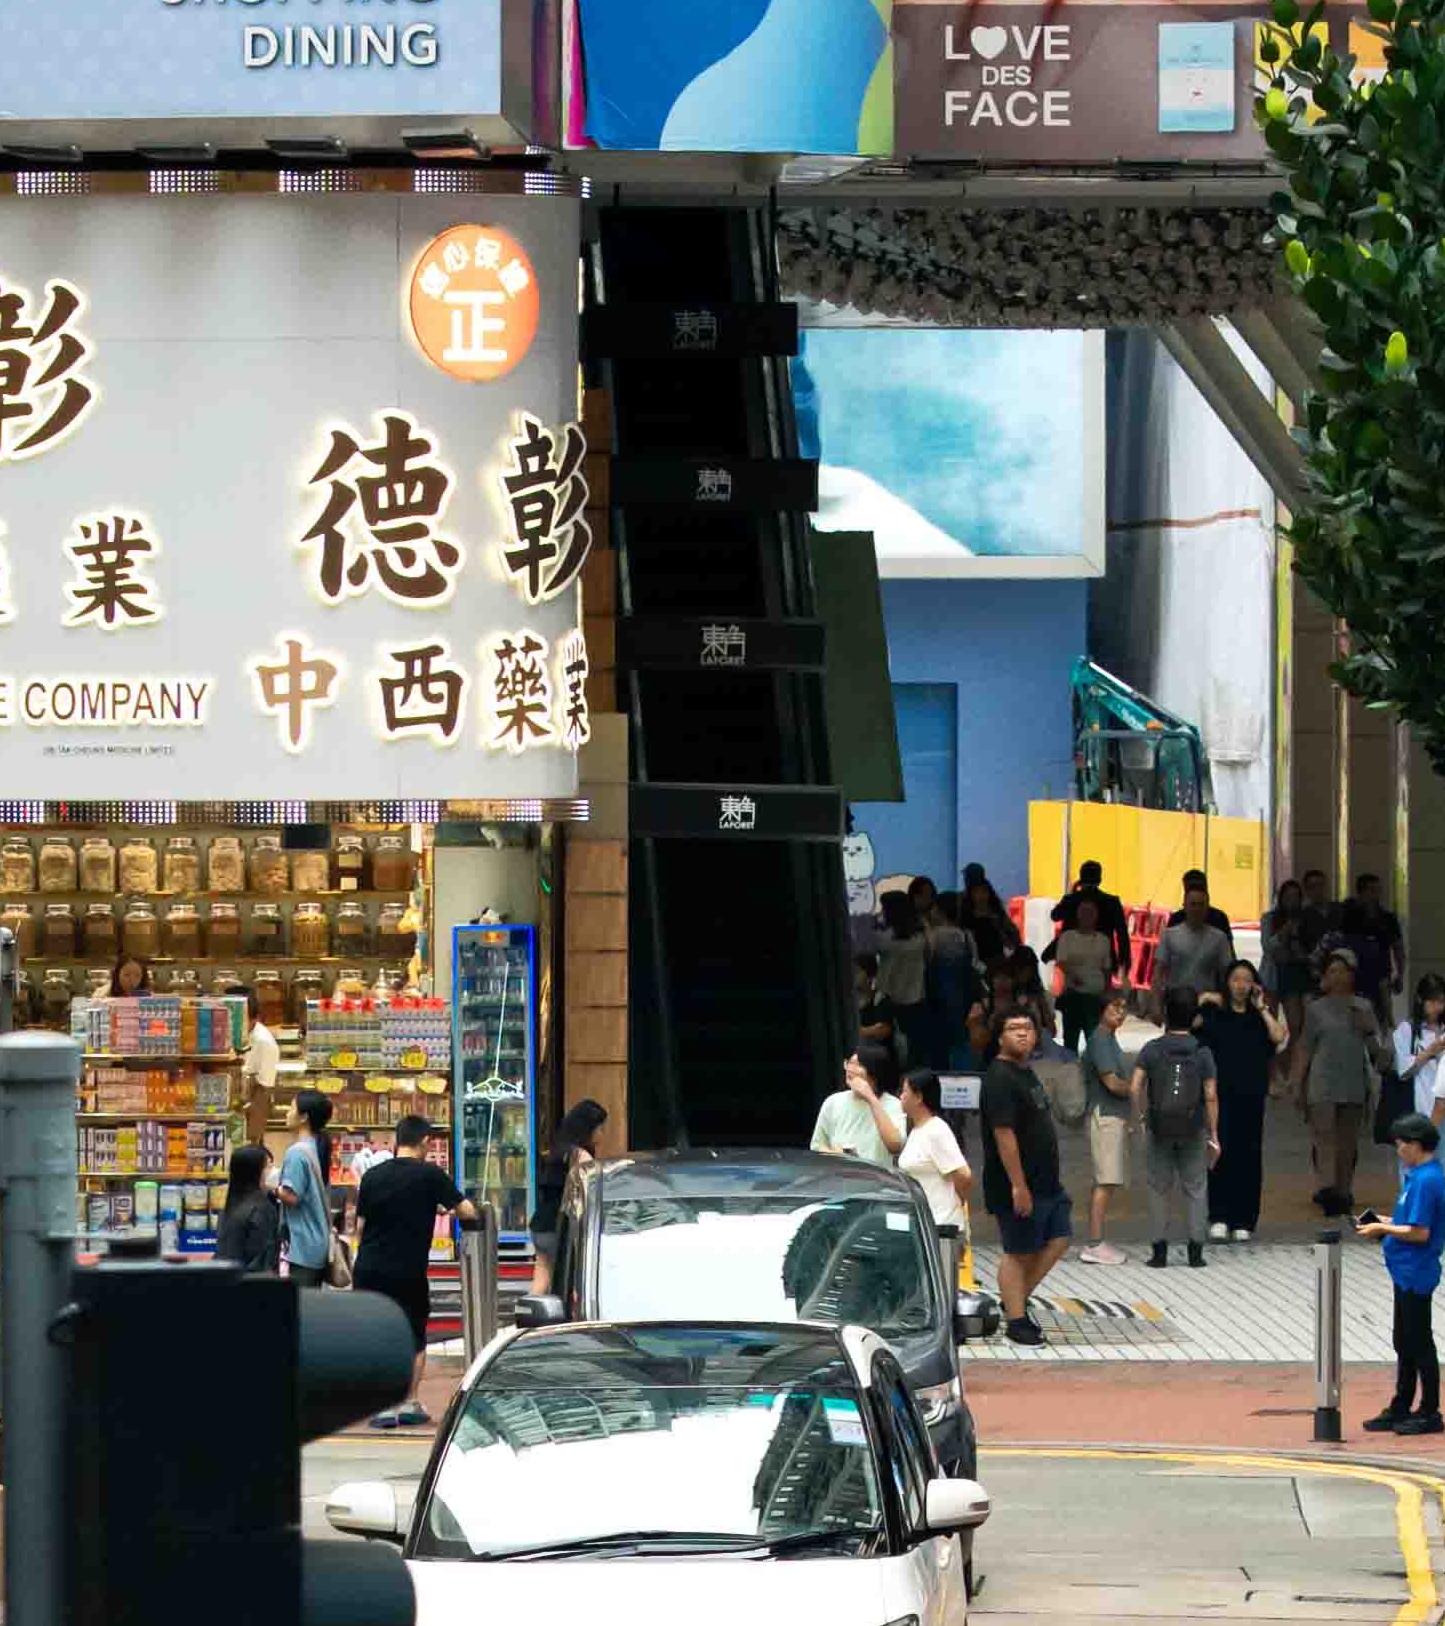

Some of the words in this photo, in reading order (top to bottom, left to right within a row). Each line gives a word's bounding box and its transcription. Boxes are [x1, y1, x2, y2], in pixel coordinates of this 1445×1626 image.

[242, 22, 440, 69] DINING
[981, 65, 1033, 87] DES
[944, 90, 1072, 127] FACE
[442, 290, 509, 362] 正
[298, 413, 589, 602] 德彰
[700, 624, 746, 657] 東角
[23, 681, 208, 721] COMPANY
[719, 795, 756, 823] 東角
